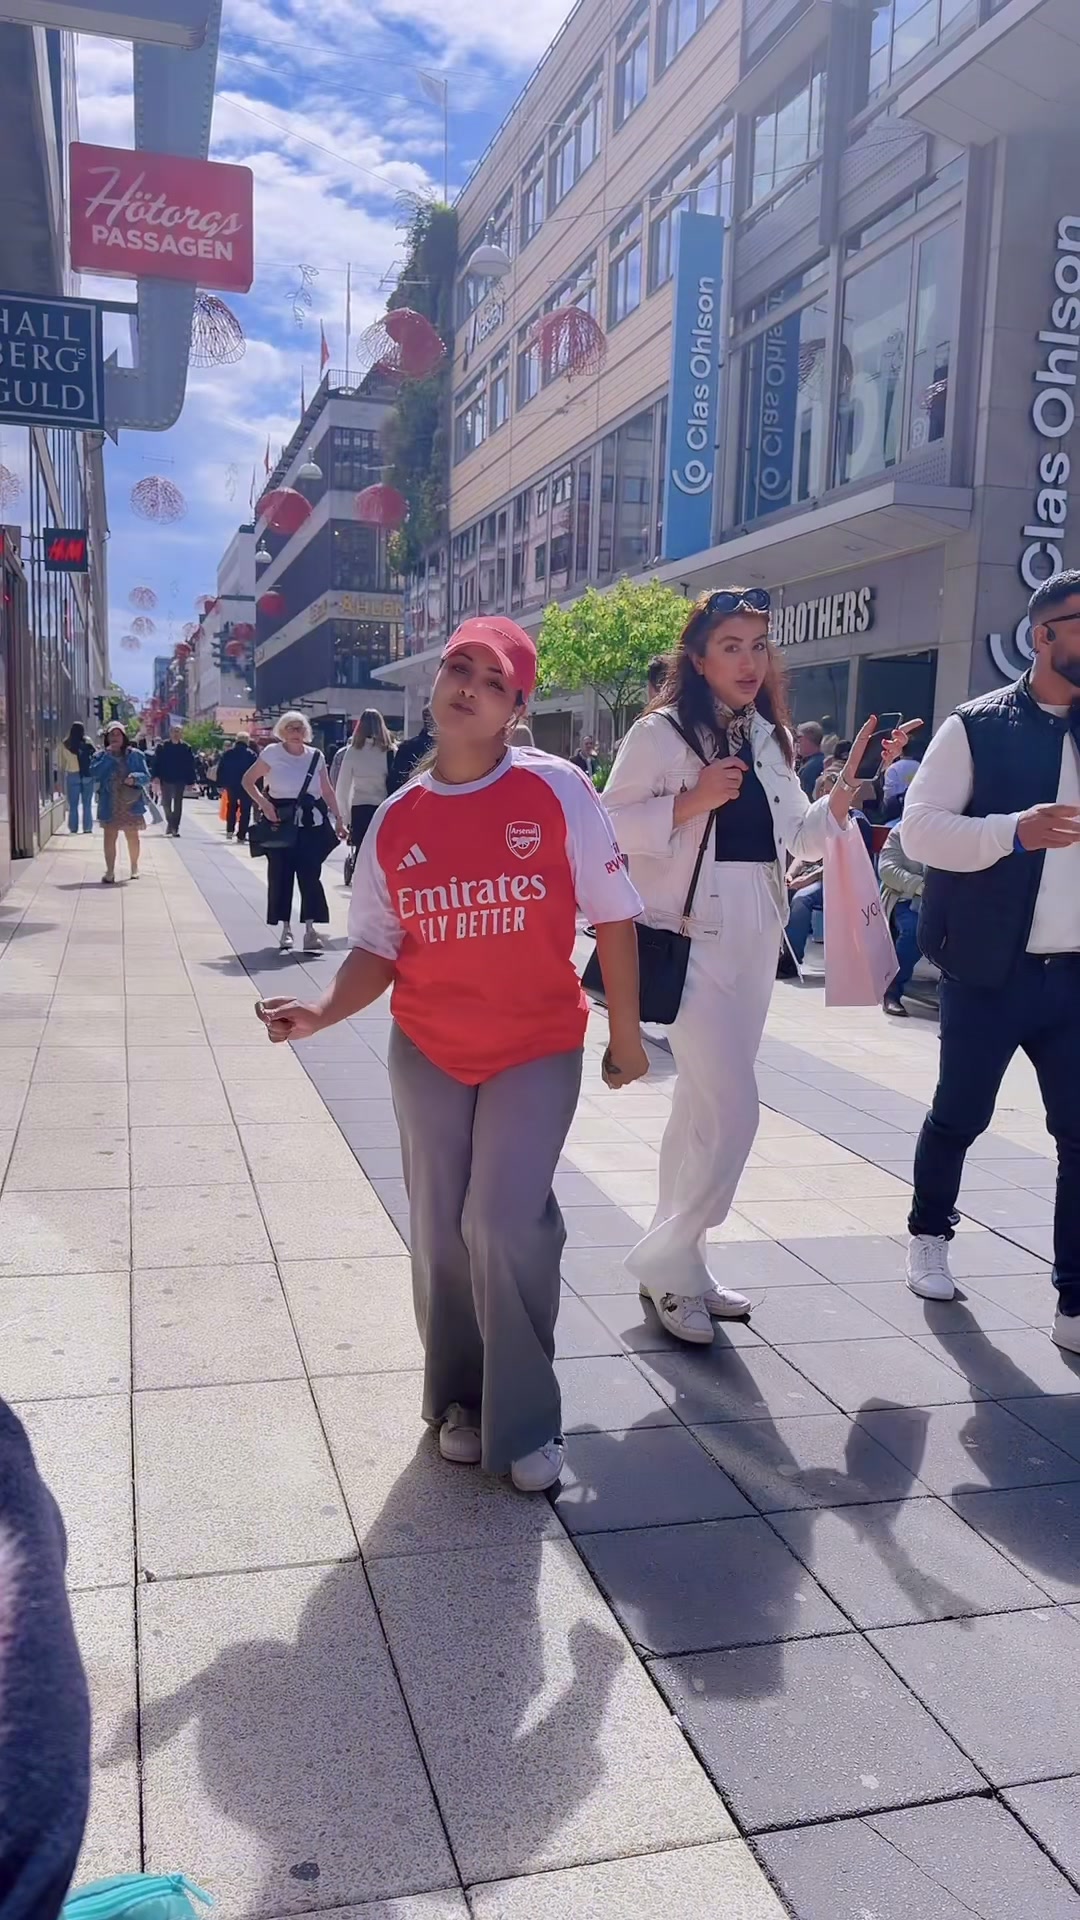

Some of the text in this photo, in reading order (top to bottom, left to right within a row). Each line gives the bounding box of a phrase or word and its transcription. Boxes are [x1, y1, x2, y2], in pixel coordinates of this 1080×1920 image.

[85, 166, 243, 238] Hötorgs
[92, 224, 233, 261] PASSAGEN
[686, 276, 715, 450] Clas Ohlson
[1021, 215, 1080, 592] Clas Ohlson
[774, 587, 871, 646] BROTHERS
[511, 827, 537, 836] Arsenal
[397, 873, 547, 919] Emirates
[419, 906, 525, 944] FLY BETTER
